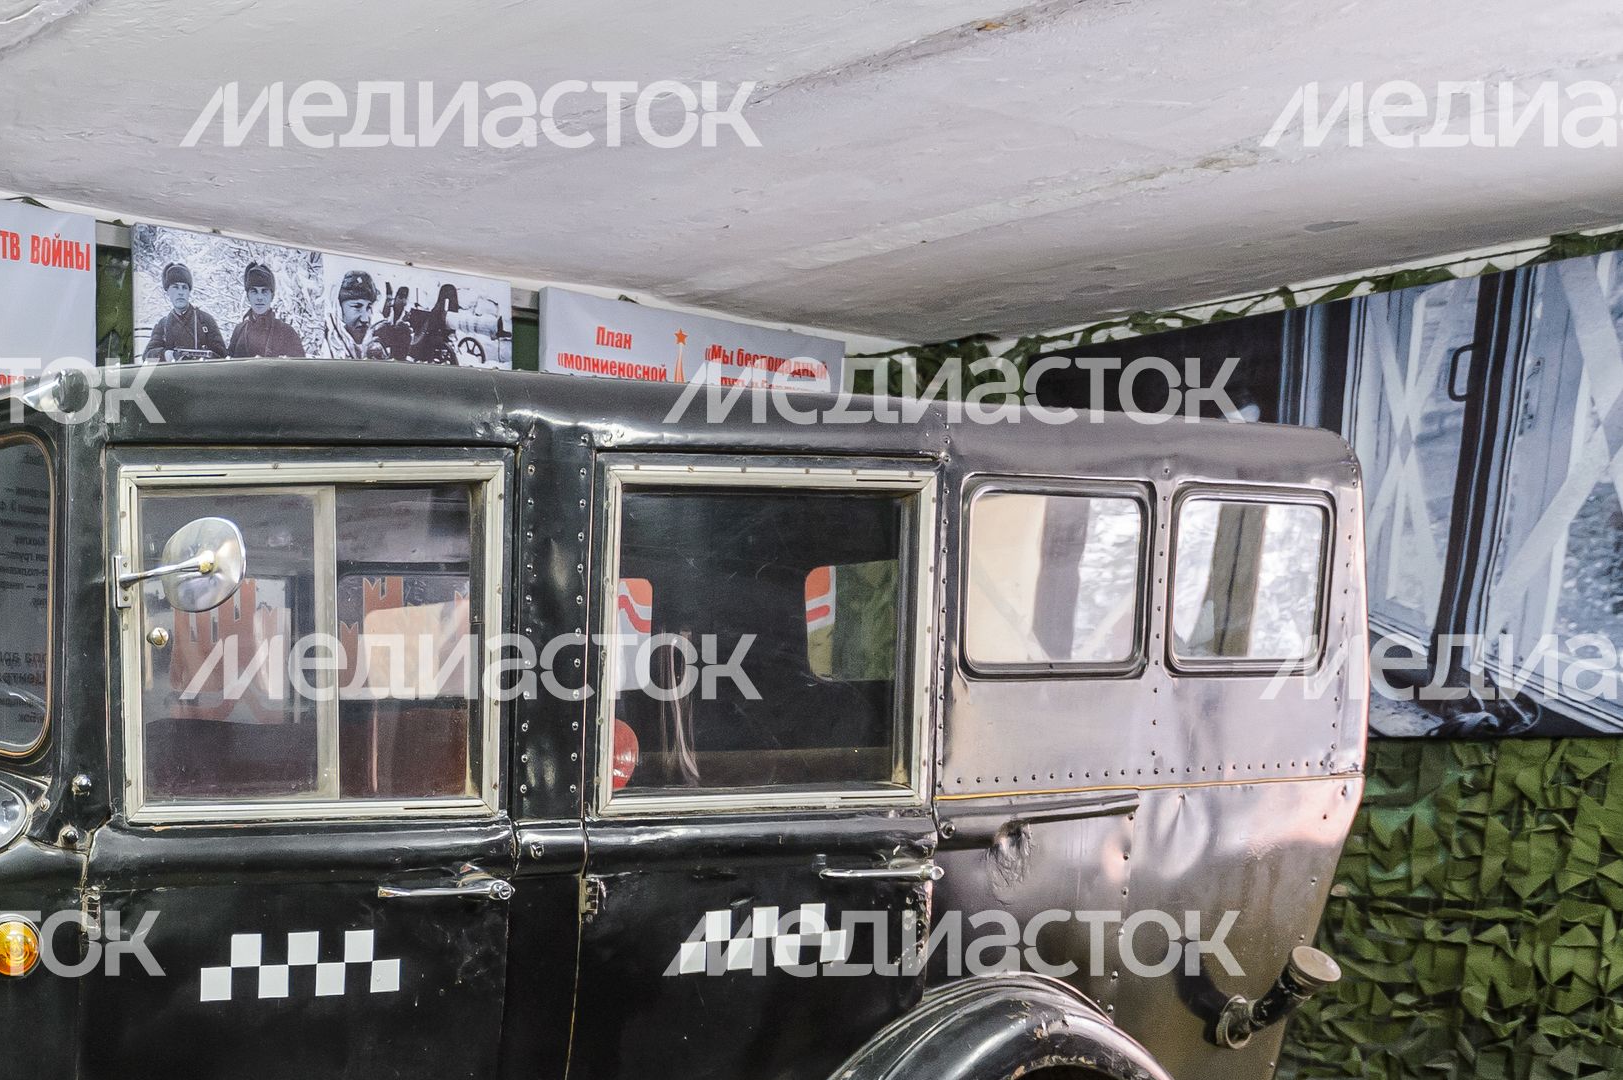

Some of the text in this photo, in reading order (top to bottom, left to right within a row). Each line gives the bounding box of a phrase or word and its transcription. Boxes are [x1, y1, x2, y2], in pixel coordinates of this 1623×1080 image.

[31, 233, 90, 271] ВОЙНЫ
[596, 326, 632, 350] План
[558, 353, 666, 381] «молниеносной
